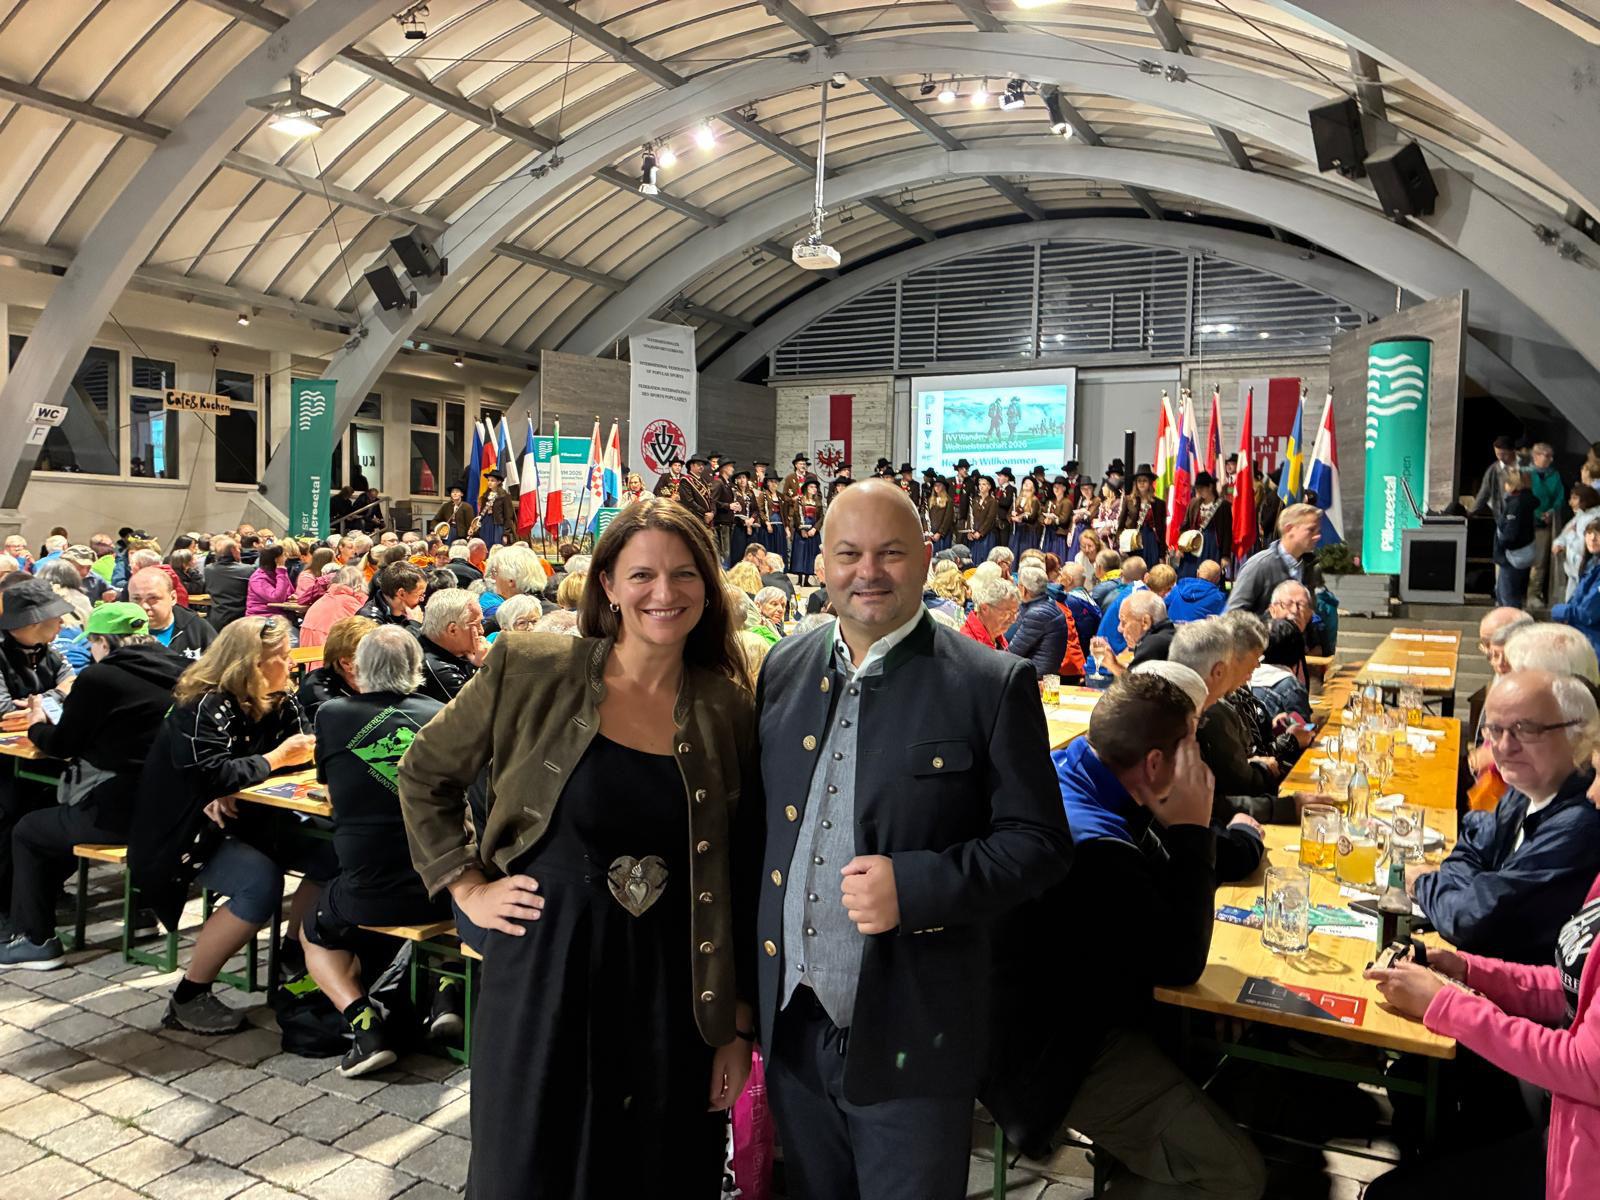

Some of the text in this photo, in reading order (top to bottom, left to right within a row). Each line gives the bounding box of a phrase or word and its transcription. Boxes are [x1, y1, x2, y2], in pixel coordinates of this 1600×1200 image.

[200, 396, 230, 411] Kuchen
[38, 407, 60, 419] WC
[32, 427, 45, 440] F
[1381, 475, 1397, 552] Pillerseetal
[345, 705, 396, 750] WANDERFREUNDE
